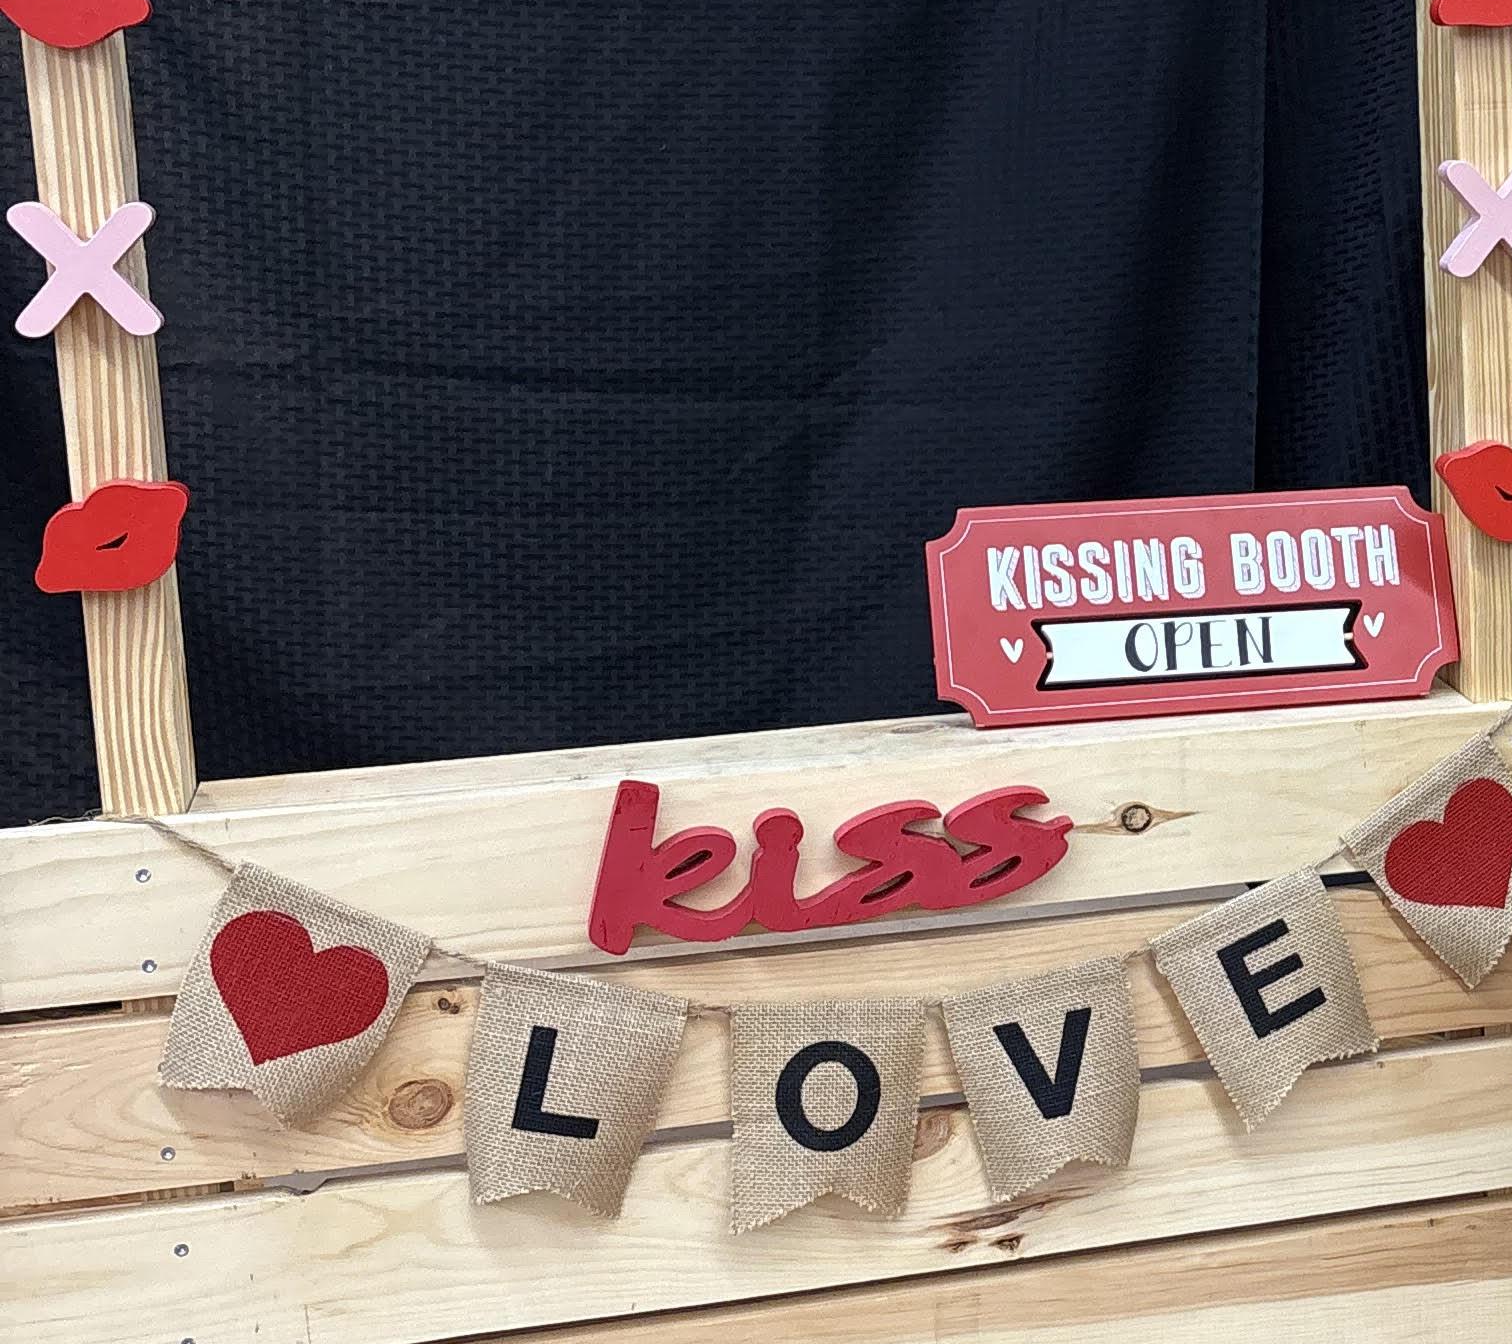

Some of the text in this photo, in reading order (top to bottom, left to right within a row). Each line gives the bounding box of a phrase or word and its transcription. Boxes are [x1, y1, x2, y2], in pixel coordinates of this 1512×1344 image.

[986, 523, 1401, 611] KISSING BOOTH
[1124, 616, 1273, 673] OPEN
[587, 779, 1074, 956] kiss
